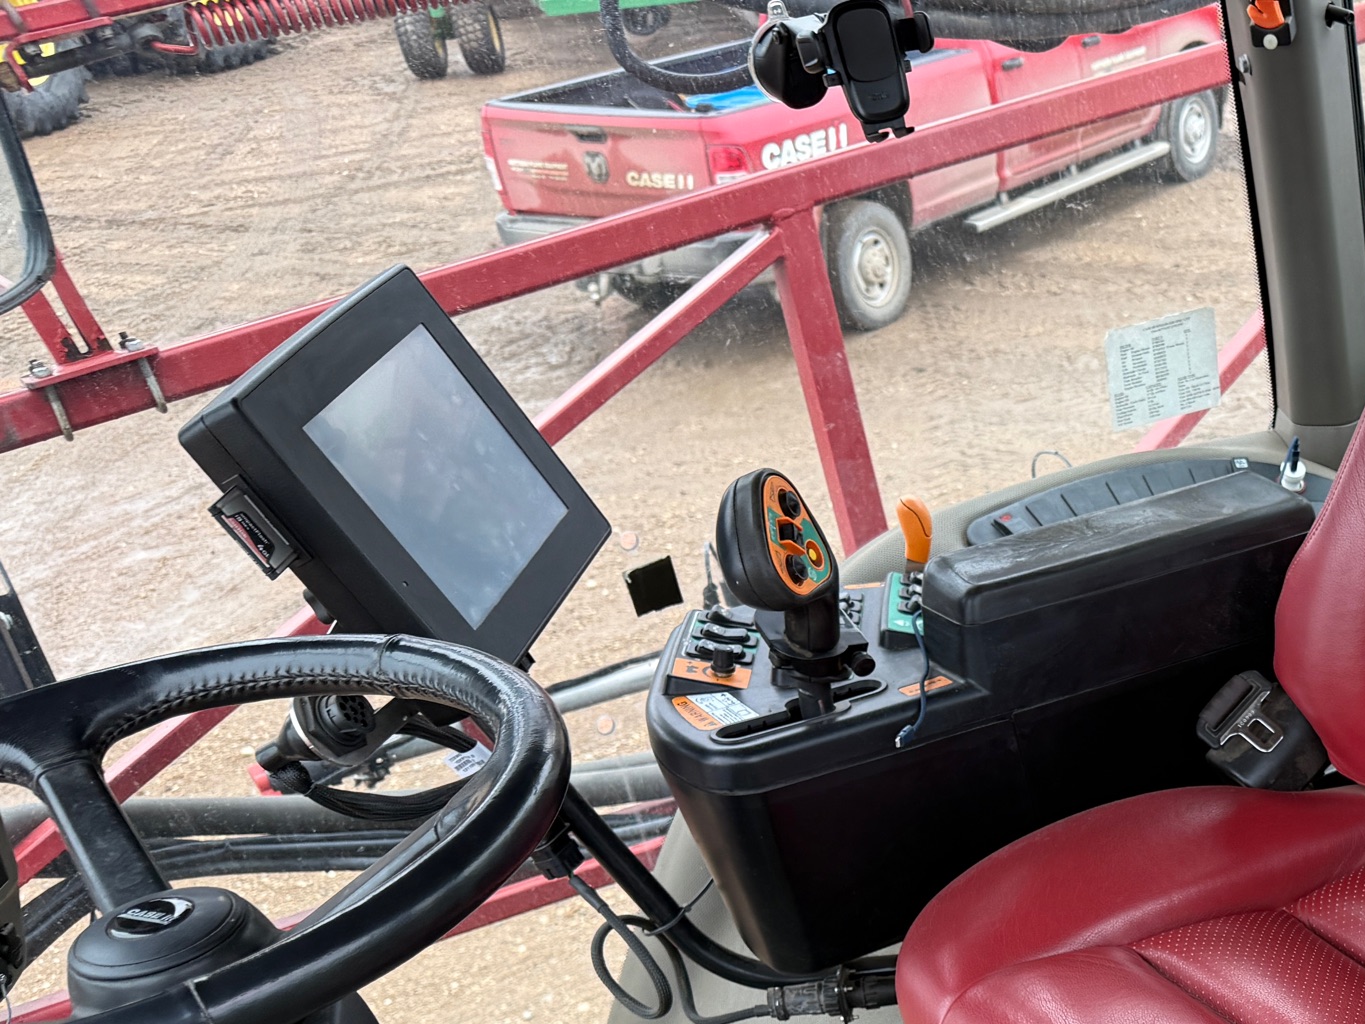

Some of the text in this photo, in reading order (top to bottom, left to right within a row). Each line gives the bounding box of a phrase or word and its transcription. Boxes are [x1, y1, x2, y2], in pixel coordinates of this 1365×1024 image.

[761, 129, 827, 170] CASE
[626, 170, 676, 189] CASE
[126, 908, 167, 920] CASE
